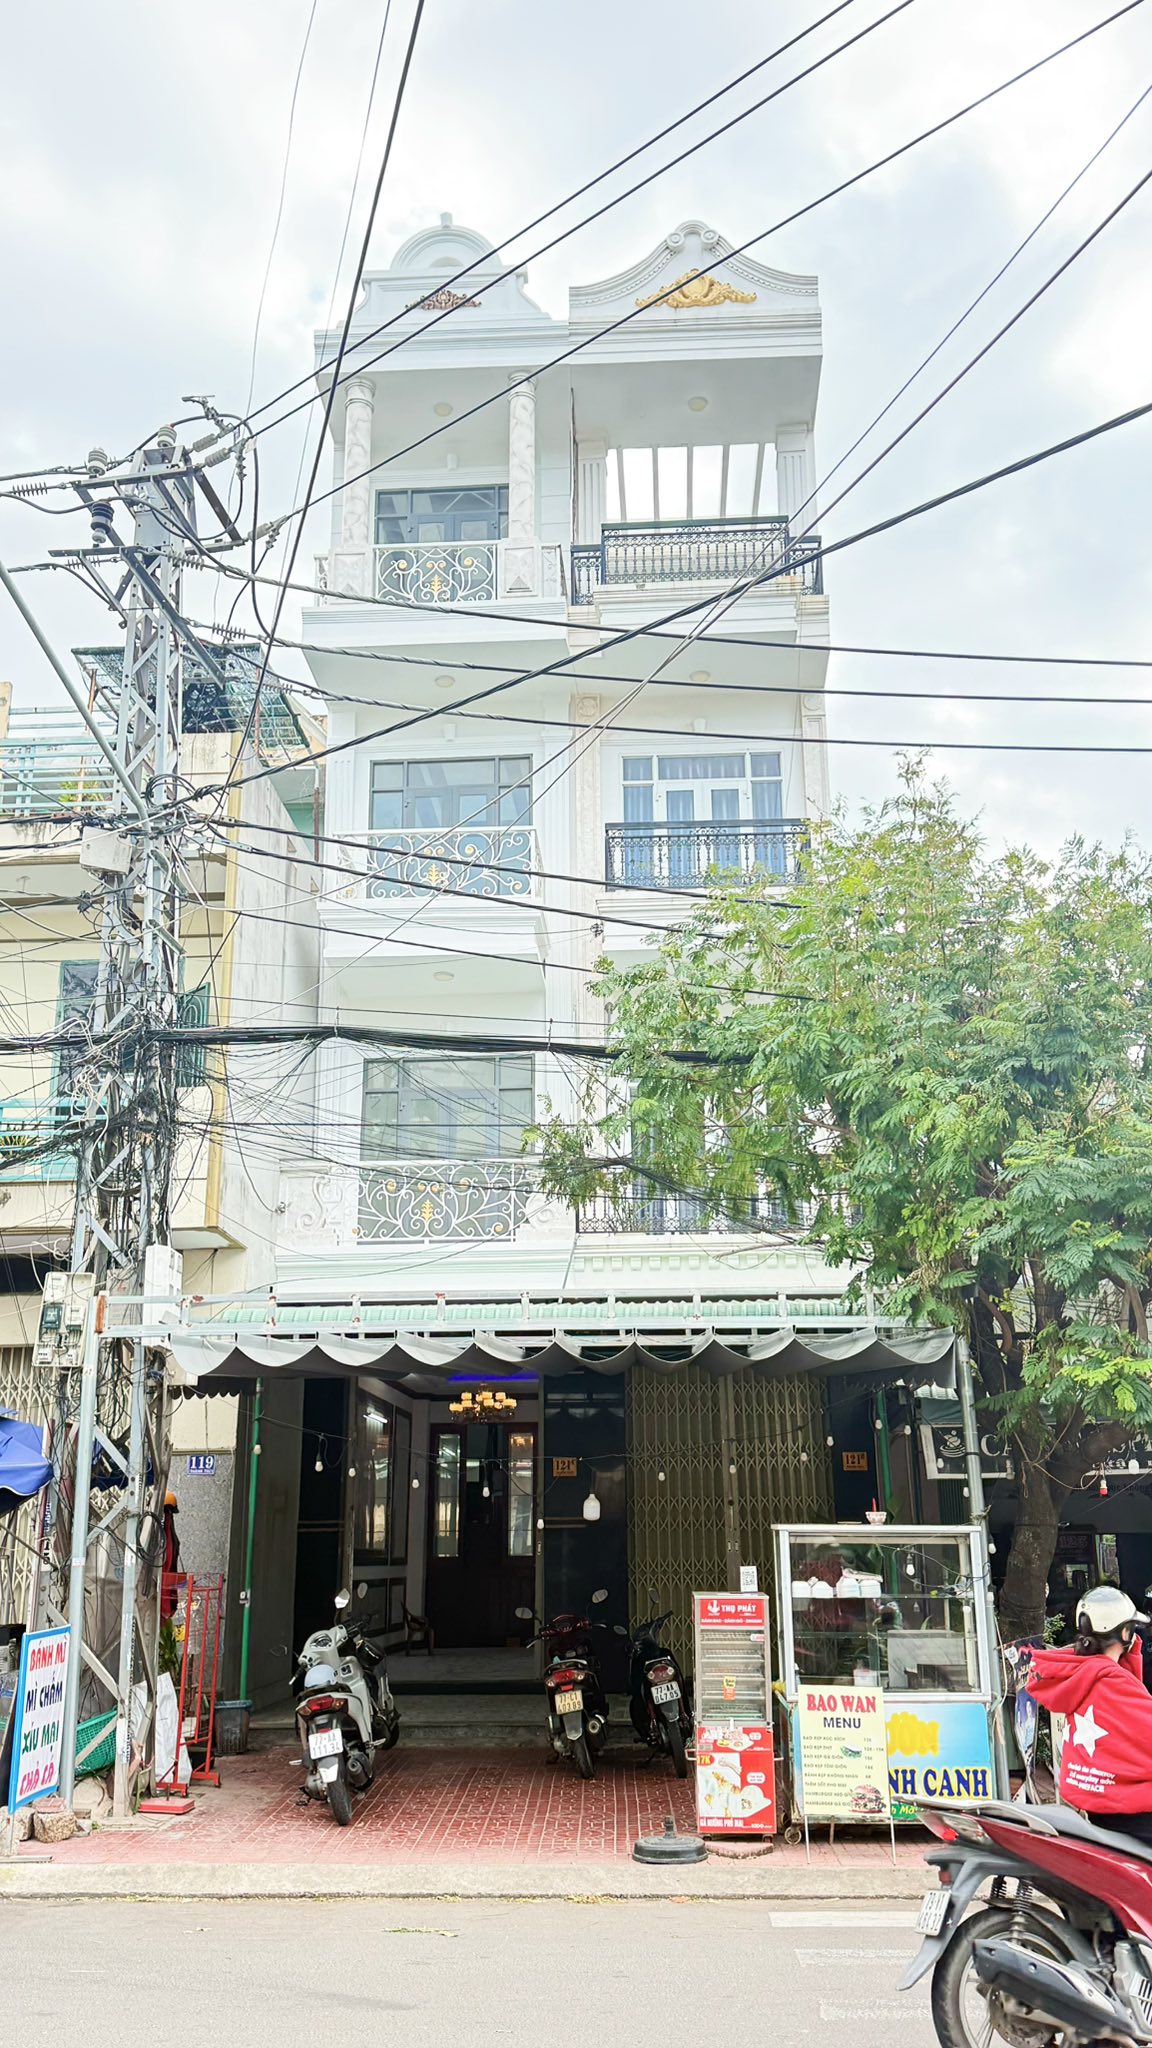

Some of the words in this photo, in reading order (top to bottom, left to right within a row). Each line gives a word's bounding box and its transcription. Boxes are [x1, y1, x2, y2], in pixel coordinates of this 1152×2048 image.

[190, 1456, 214, 1469] 119
[737, 1602, 757, 1613] PHÁT
[29, 1640, 54, 1672] BÁNH
[806, 1693, 838, 1712] BAO
[840, 1695, 876, 1713] WAN
[823, 1717, 861, 1728] MENU
[22, 1722, 39, 1756] XÍU
[888, 1769, 917, 1795] NH
[923, 1769, 988, 1797] CANH
